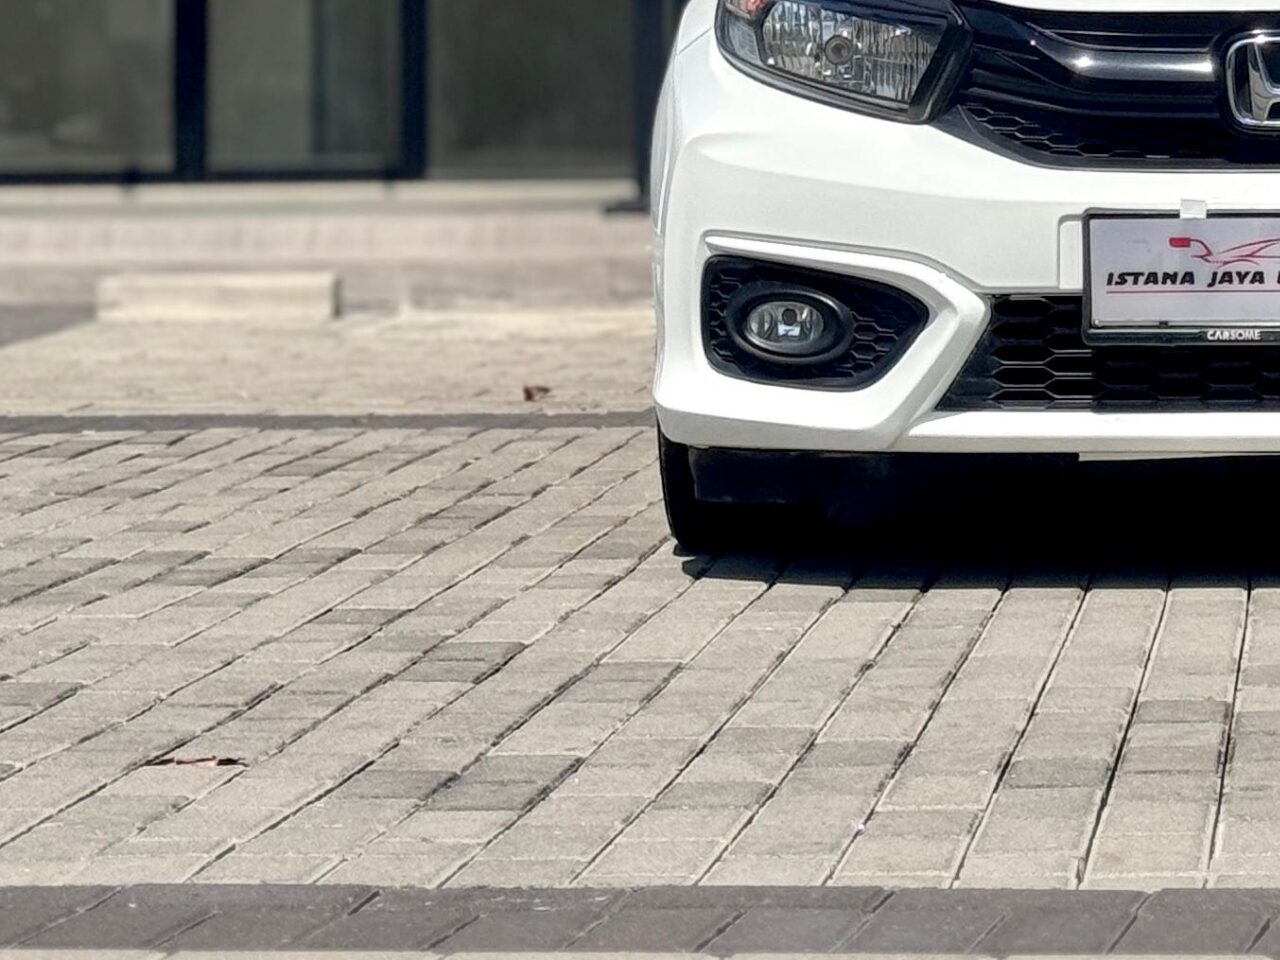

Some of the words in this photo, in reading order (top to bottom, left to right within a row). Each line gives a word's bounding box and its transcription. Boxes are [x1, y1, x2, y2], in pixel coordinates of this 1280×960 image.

[1106, 271, 1195, 286] ISTANA
[1207, 271, 1266, 287] JAYA
[1206, 330, 1261, 340] CARSOME
